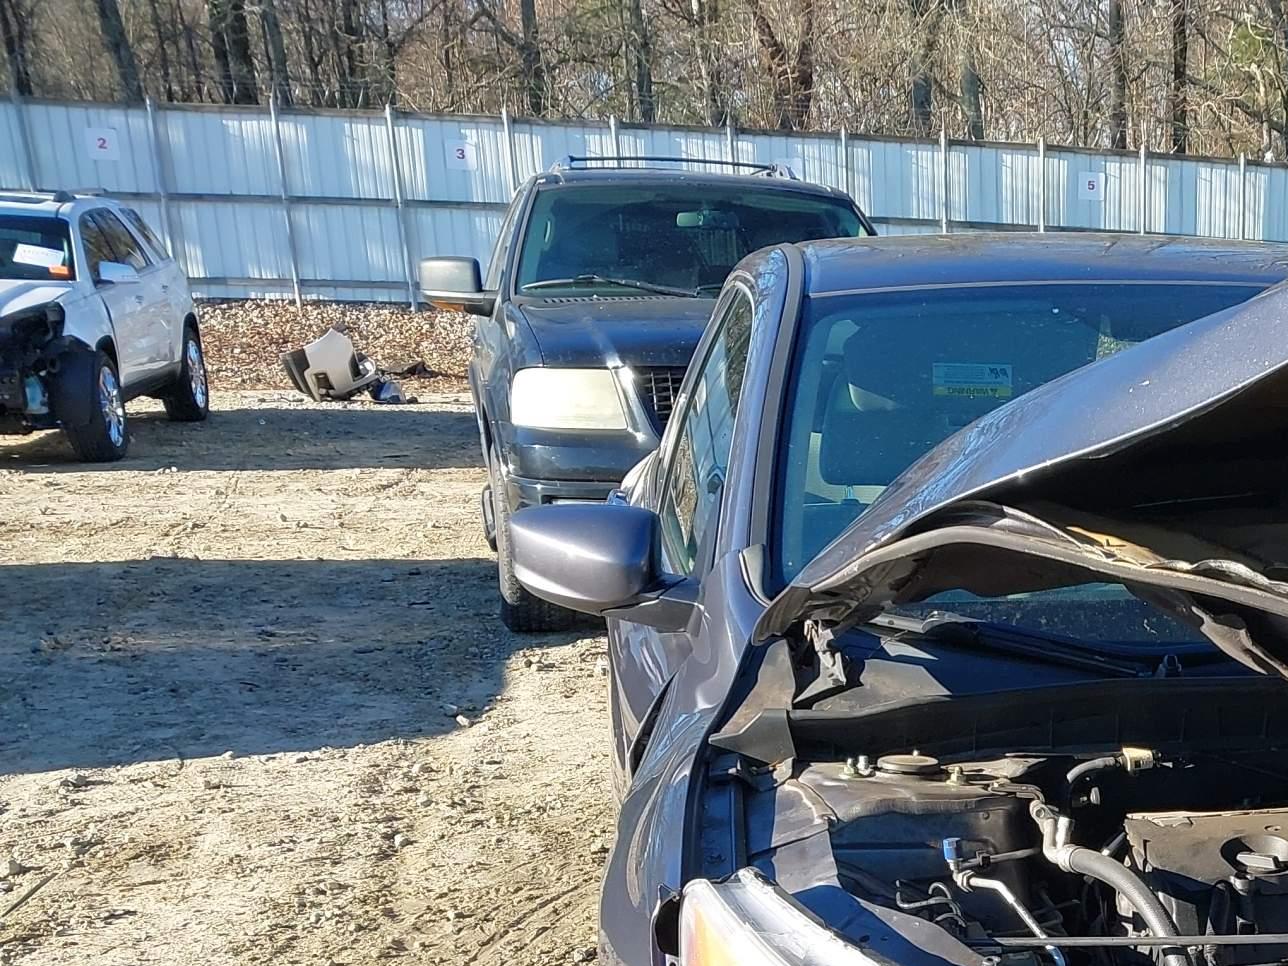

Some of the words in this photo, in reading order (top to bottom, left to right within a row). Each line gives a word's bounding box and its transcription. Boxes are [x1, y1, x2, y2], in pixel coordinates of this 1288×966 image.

[97, 137, 108, 149] 2
[456, 148, 466, 160] 3
[1087, 180, 1096, 191] 5
